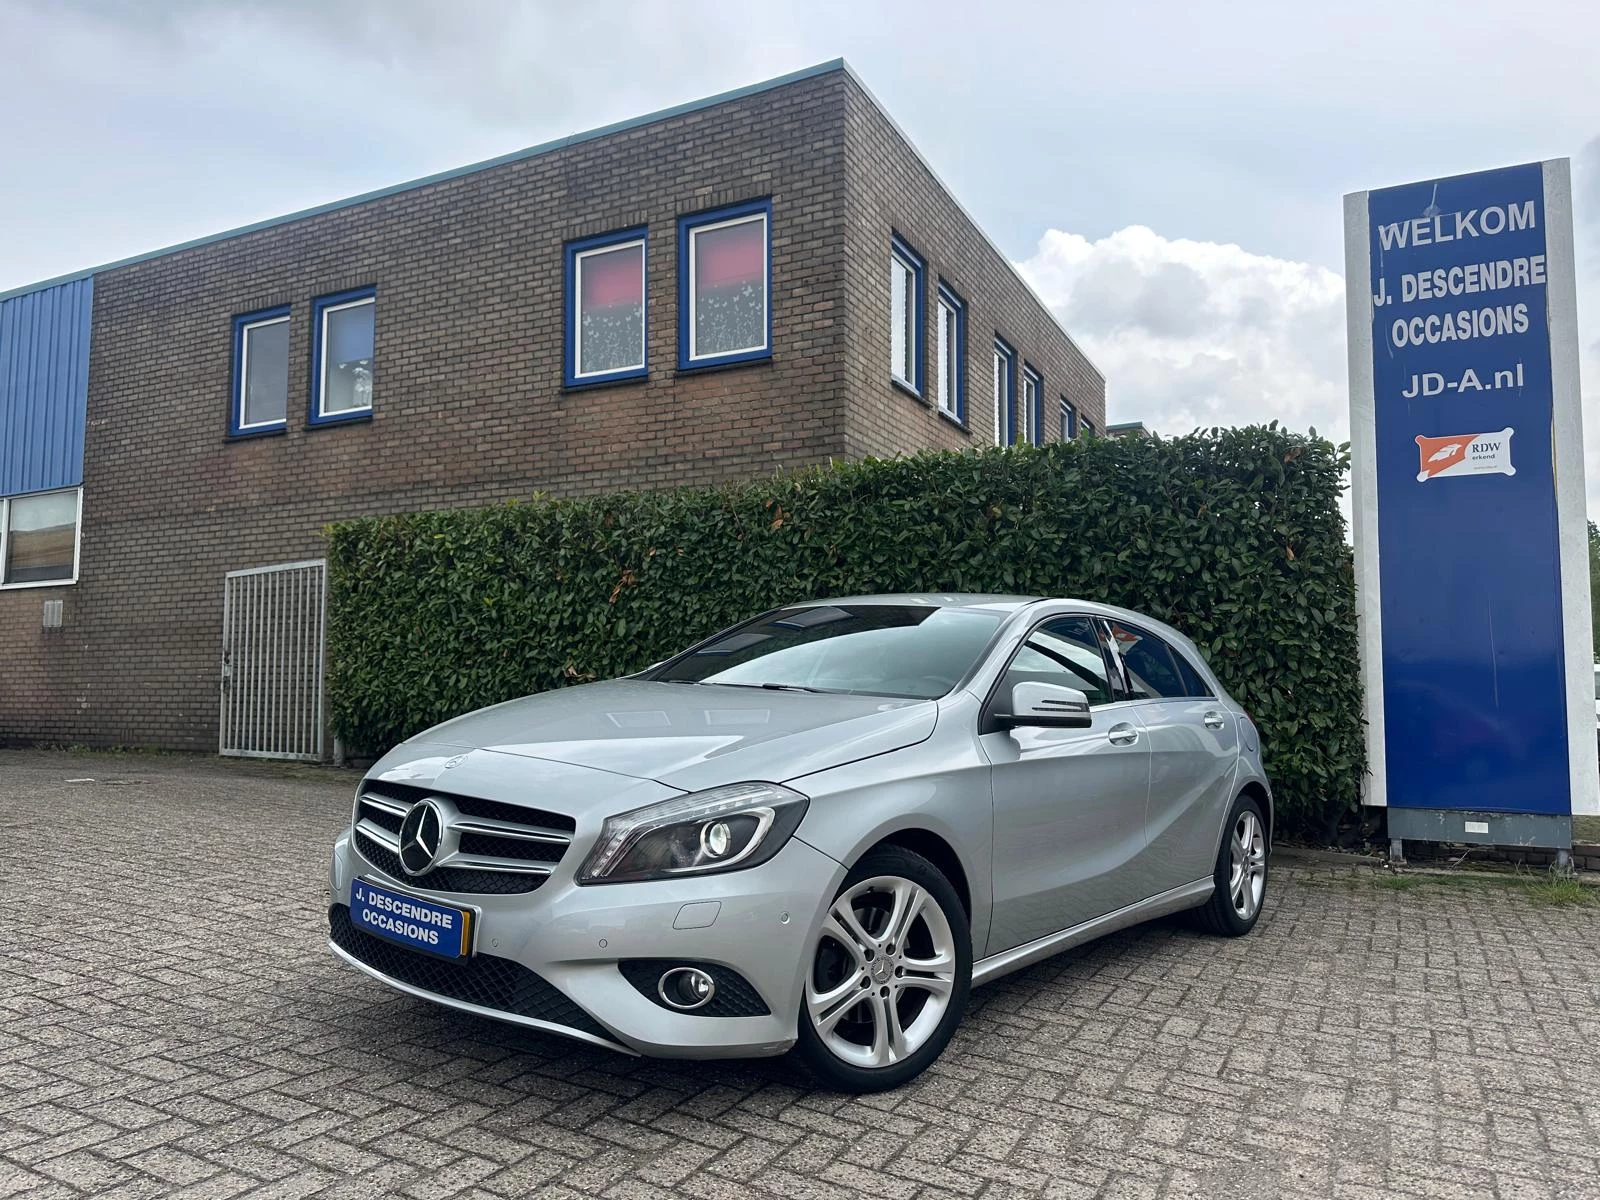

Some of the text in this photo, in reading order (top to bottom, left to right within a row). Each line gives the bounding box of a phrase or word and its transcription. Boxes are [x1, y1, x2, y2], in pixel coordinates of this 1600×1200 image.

[1378, 200, 1536, 251] WELKOM
[1373, 254, 1547, 307] J. DESCENDRE
[1391, 303, 1529, 348] OCCASIONS
[1402, 363, 1524, 399] JD-A.nl
[1471, 442, 1501, 453] RDW
[1471, 453, 1496, 461] erkend
[355, 887, 453, 929] J. DESCENDRE
[362, 908, 439, 945] OCCASIONS
